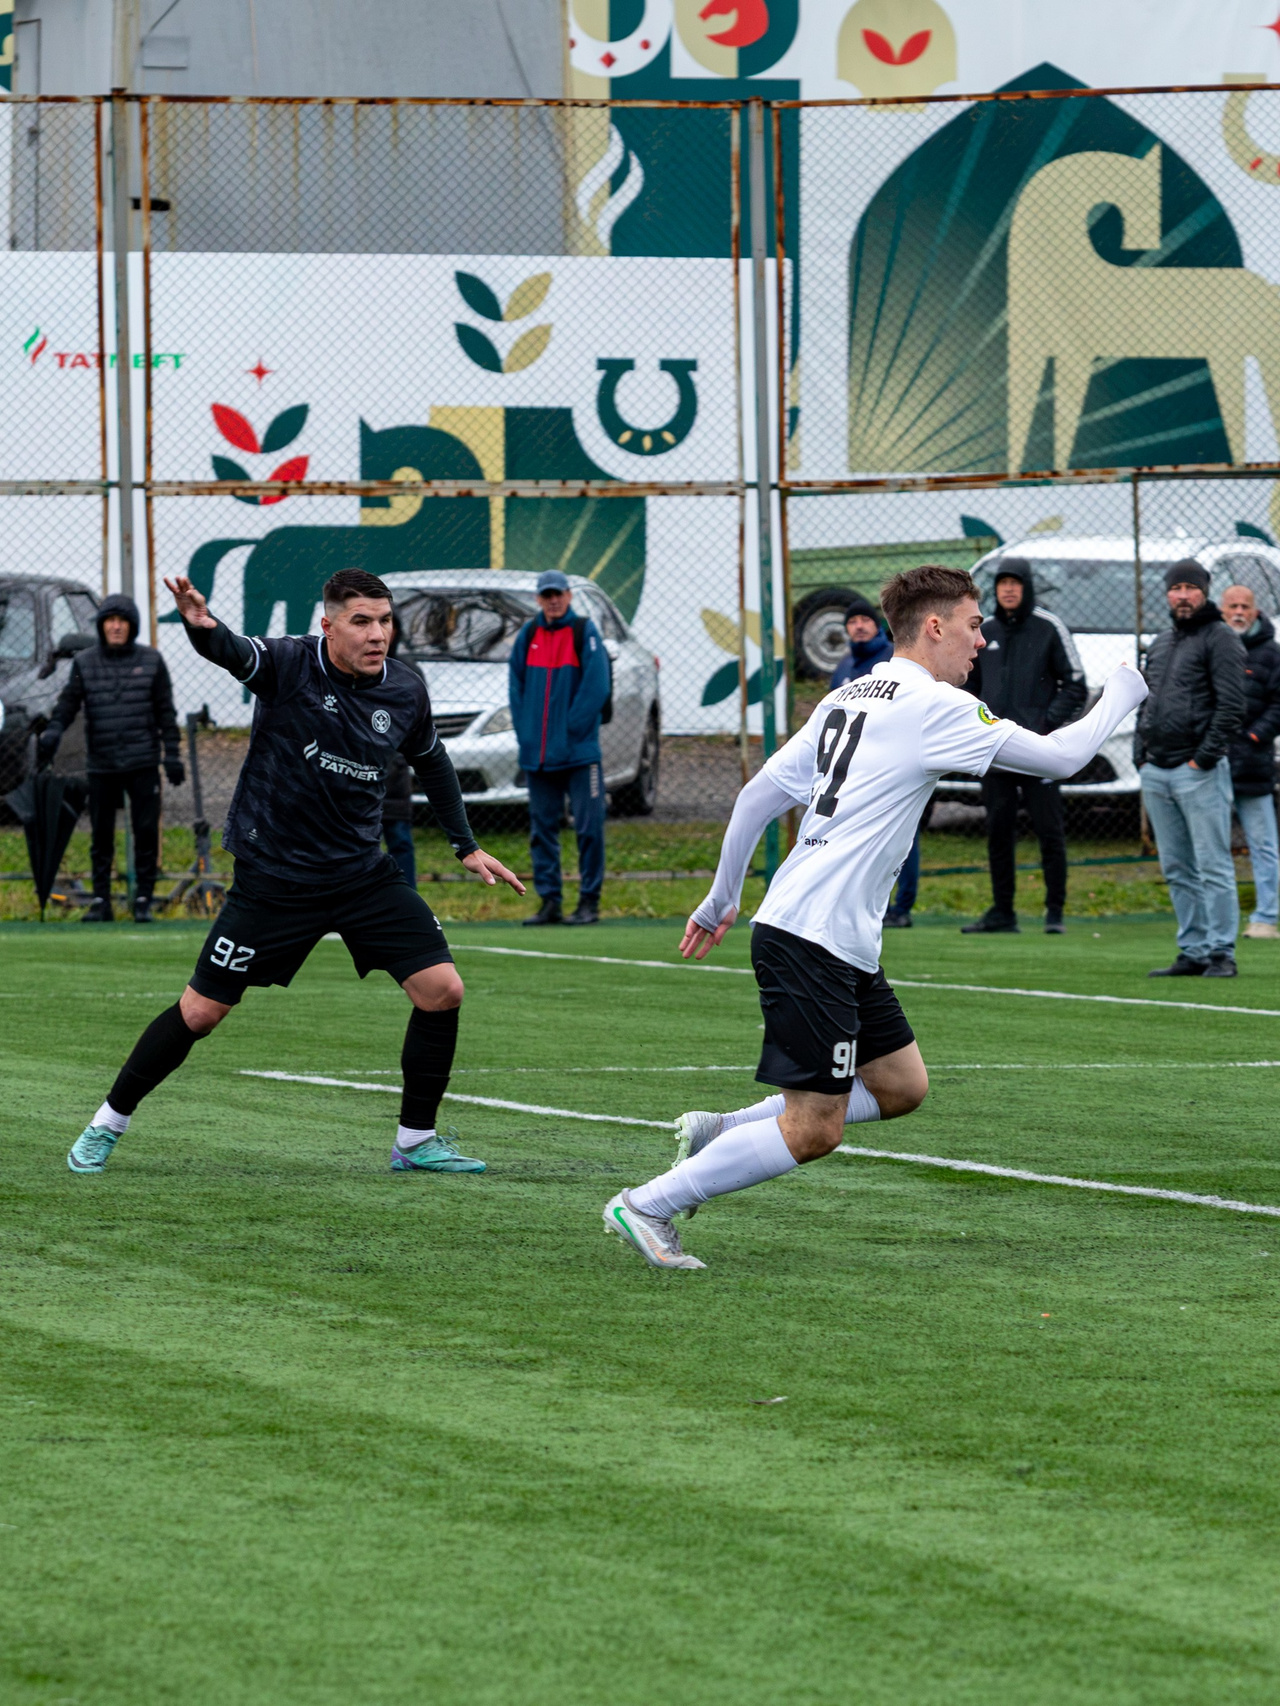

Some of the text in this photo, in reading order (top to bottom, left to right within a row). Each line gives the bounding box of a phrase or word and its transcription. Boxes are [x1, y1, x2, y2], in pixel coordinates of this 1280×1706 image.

[319, 757, 379, 781] TATNEFT
[811, 708, 867, 818] 91
[210, 936, 256, 972] 92
[831, 1040, 857, 1078] 91
